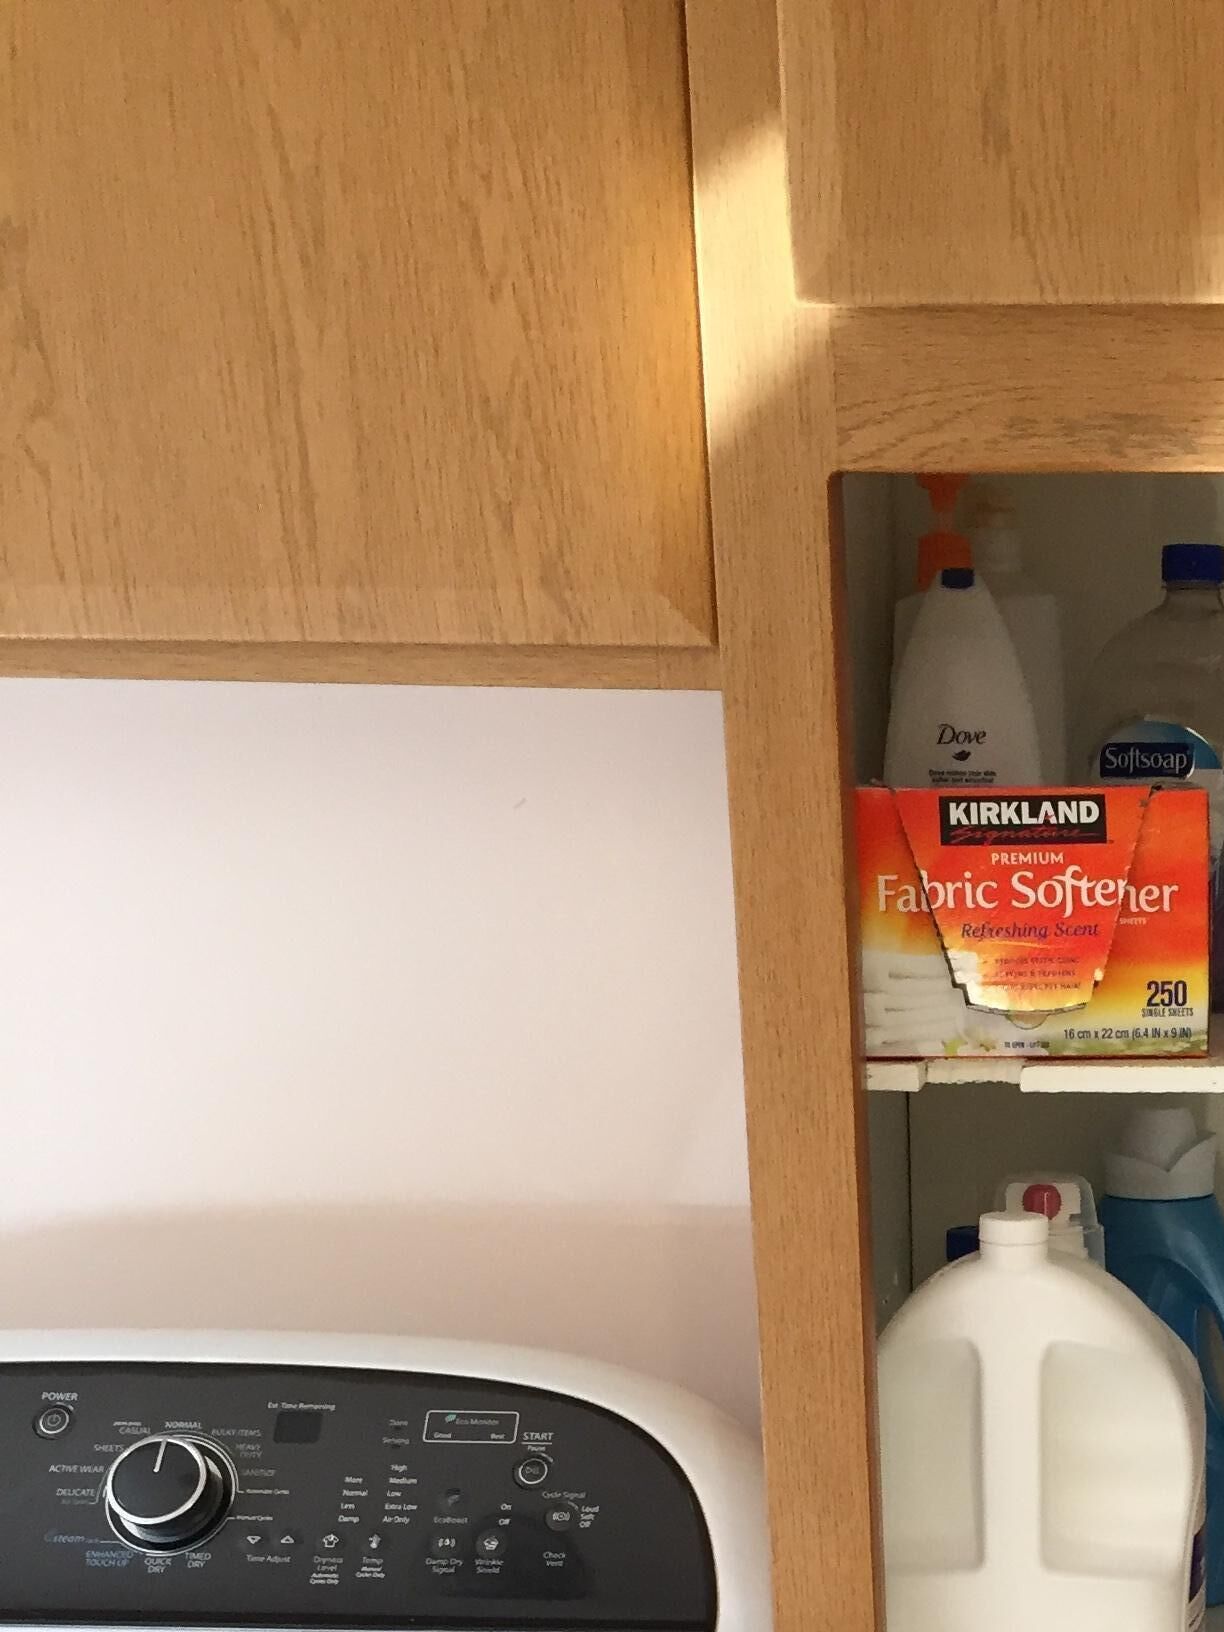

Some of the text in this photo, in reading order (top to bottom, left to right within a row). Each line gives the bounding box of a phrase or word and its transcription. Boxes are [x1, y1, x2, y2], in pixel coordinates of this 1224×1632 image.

[936, 723, 987, 745] Dove
[1105, 746, 1188, 775] Softsoap
[949, 800, 1100, 826] KIRKLAND
[991, 852, 1065, 866] PREMIUM
[876, 864, 1179, 918] Fabric Softener
[1119, 917, 1148, 926] SHEETS
[961, 921, 1100, 941] Refreshing Scent
[1146, 980, 1188, 1008] 250
[1142, 1007, 1194, 1017] SINGLE SHEETS
[1064, 1029, 1075, 1040] 16
[1078, 1031, 1092, 1040] cm
[1094, 1031, 1100, 1040] x
[1102, 1029, 1113, 1040] 22
[1115, 1031, 1130, 1040] cm
[1132, 1028, 1149, 1041] (6.4
[1152, 1029, 1161, 1040] IN
[1163, 1031, 1170, 1039] x
[1172, 1029, 1178, 1040] 9
[41, 1392, 79, 1402] POWER
[281, 1402, 298, 1410] Time
[299, 1402, 336, 1412] Remaining
[119, 1426, 151, 1435] CASUAL
[165, 1421, 202, 1431] NORMAL
[522, 1431, 554, 1441] START
[93, 1444, 125, 1453] SHEETS
[49, 1464, 105, 1474] ACTIVE WEAR
[391, 1465, 408, 1474] High
[344, 1476, 363, 1485] More
[389, 1477, 418, 1486] Medium
[56, 1488, 97, 1498] DELICATE
[342, 1489, 369, 1498] Normal
[386, 1489, 402, 1498] Low
[541, 1491, 587, 1500] Cycle Signal
[403, 1503, 418, 1512] Low
[501, 1503, 512, 1511] On
[581, 1505, 600, 1513] Loud
[338, 1515, 360, 1524] Damp
[382, 1515, 411, 1525] Air Only
[498, 1518, 512, 1527] Off
[579, 1521, 593, 1529] Off
[53, 1535, 85, 1545] steam
[85, 1550, 134, 1560] ENHANCED
[185, 1552, 212, 1561] TIMED
[246, 1554, 291, 1564] Time Adjust
[313, 1555, 344, 1565] Dryness
[542, 1551, 567, 1560] Check
[85, 1558, 131, 1569] TOUCH UP
[144, 1557, 172, 1567] QUICK
[187, 1560, 206, 1569] DRY
[361, 1556, 384, 1565] Temp
[425, 1557, 463, 1568] Damp Dry
[147, 1565, 167, 1575] DRY
[317, 1564, 338, 1572] Level
